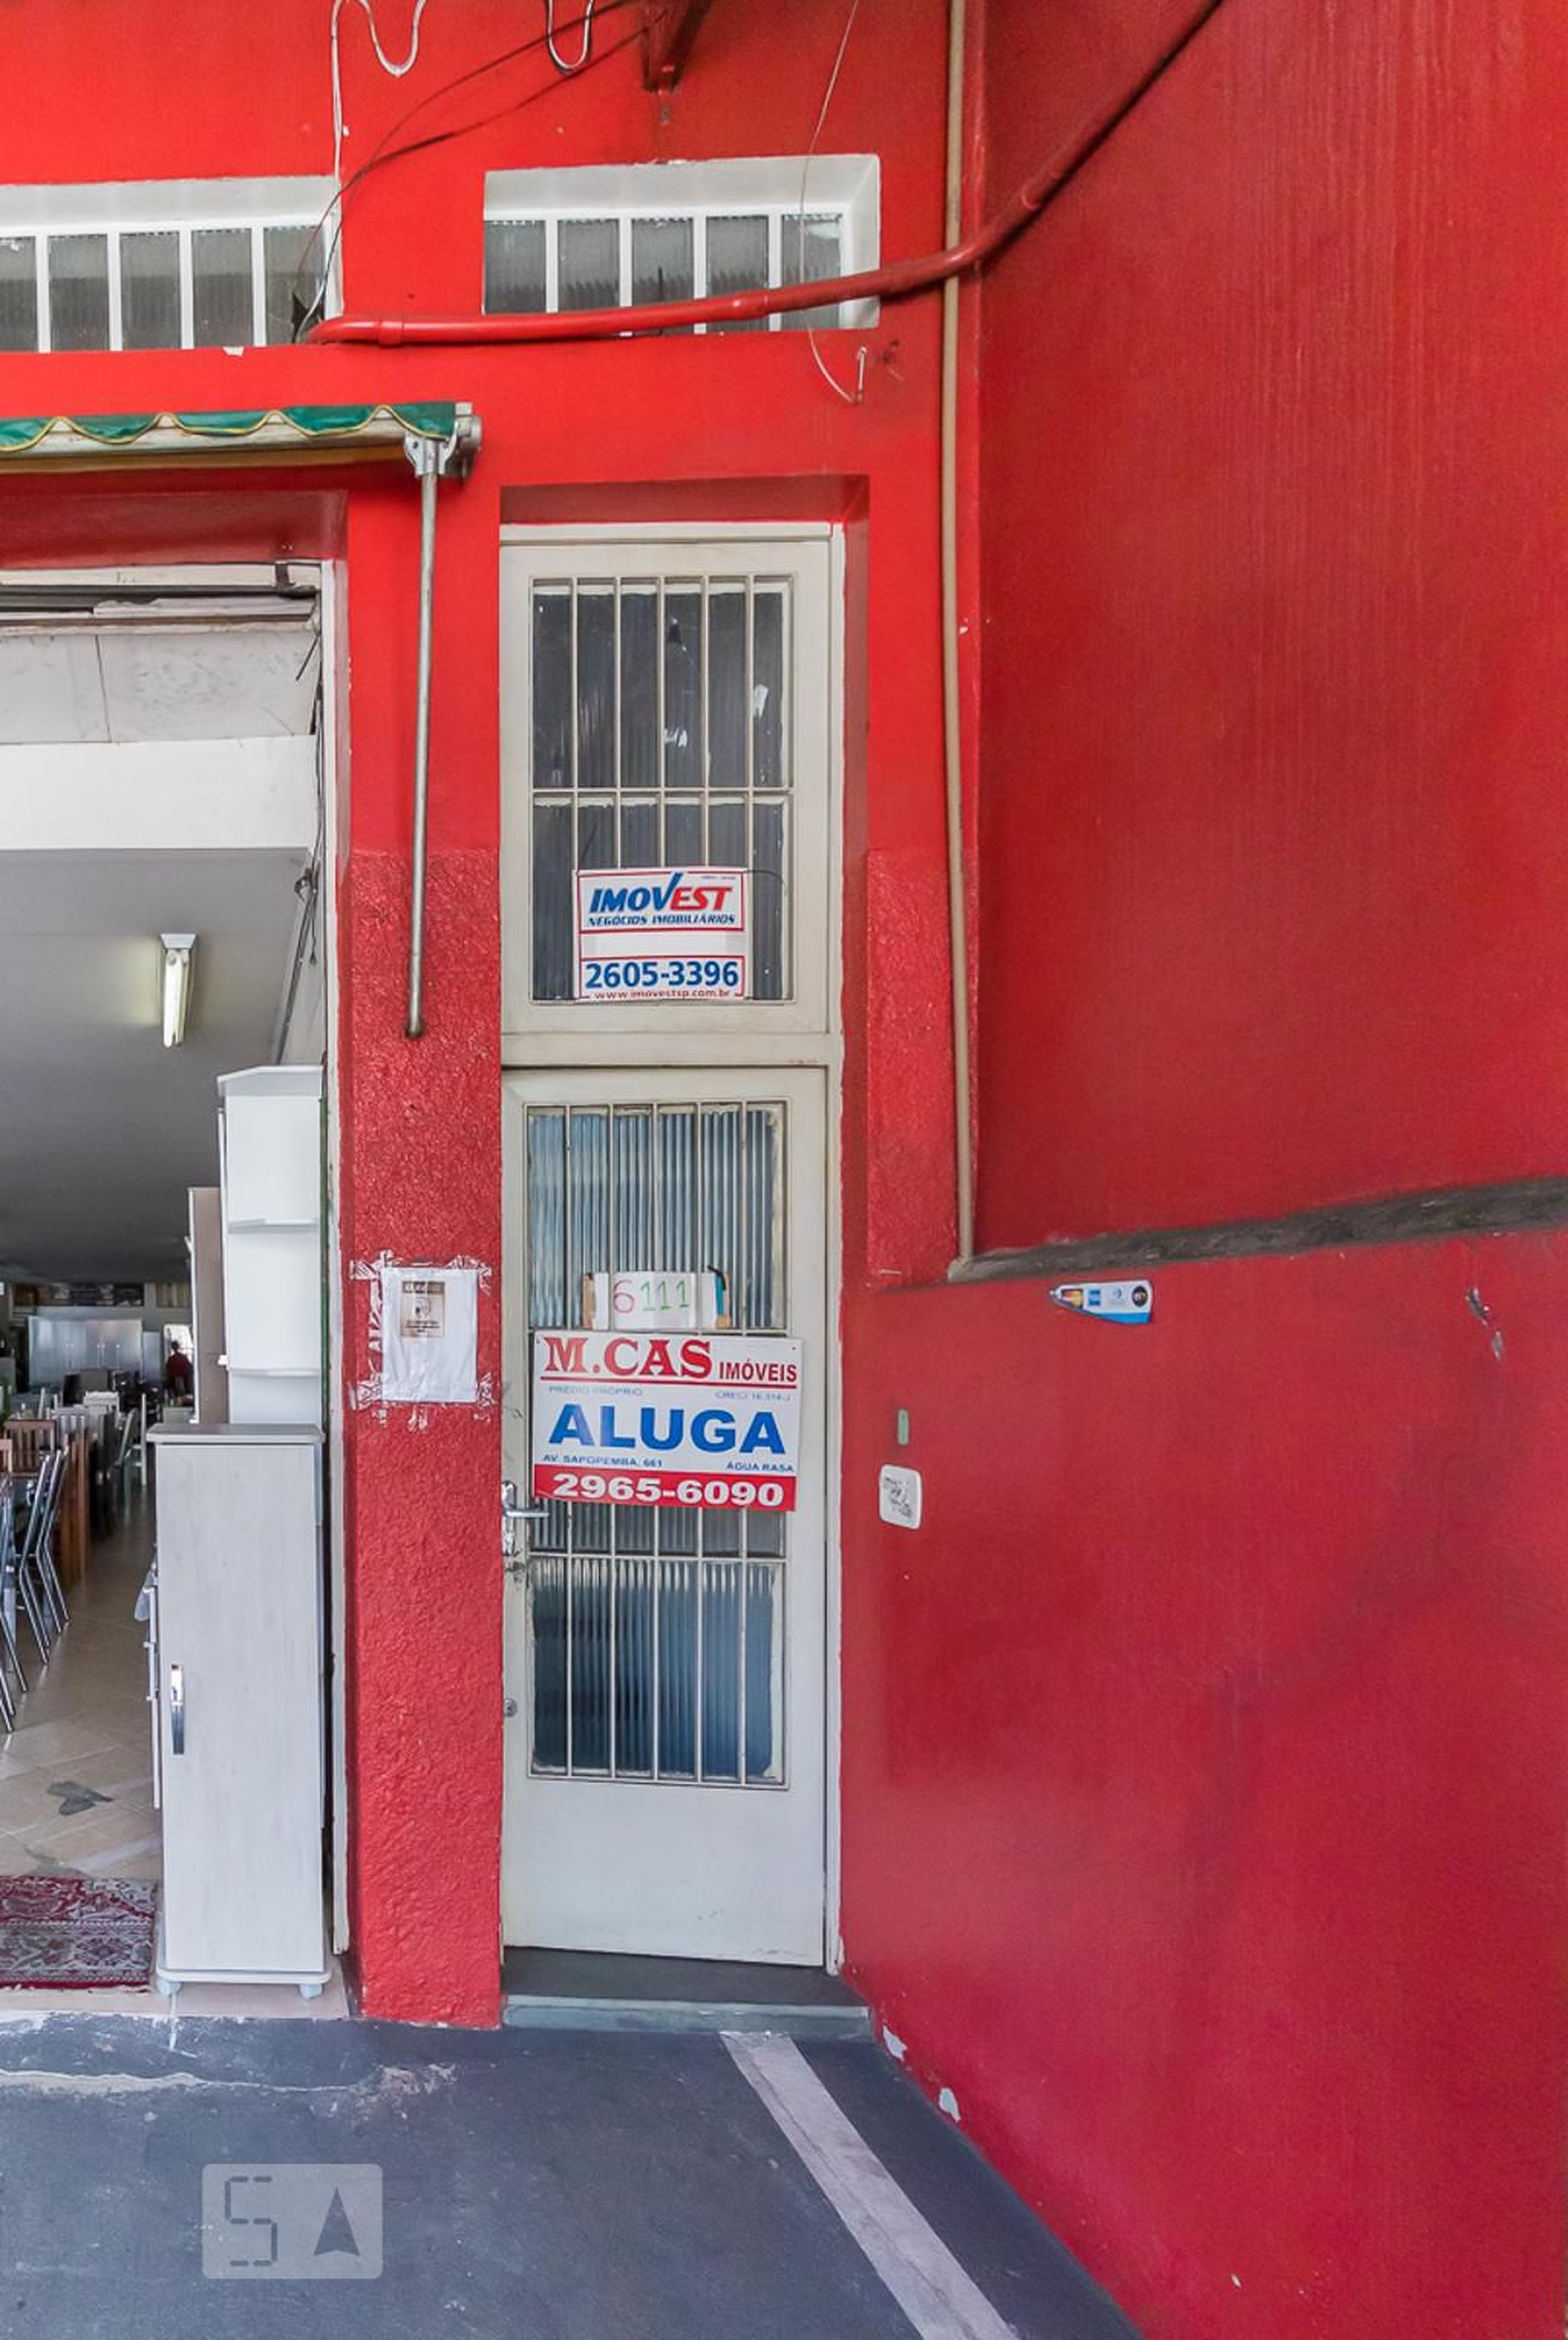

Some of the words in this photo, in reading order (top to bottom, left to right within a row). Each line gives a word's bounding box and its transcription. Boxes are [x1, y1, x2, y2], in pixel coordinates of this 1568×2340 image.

[589, 872, 733, 913] IMOVEST
[653, 913, 735, 924] IMOBILIÁRIOS
[586, 961, 739, 989] 2605-3396
[594, 989, 731, 999] www.imovestsp.com.br
[543, 1337, 713, 1379] M.CAS
[719, 1359, 797, 1383] IMÓVEIS
[549, 1404, 785, 1455] ALUGA
[552, 1472, 784, 1507] 2965-6090
